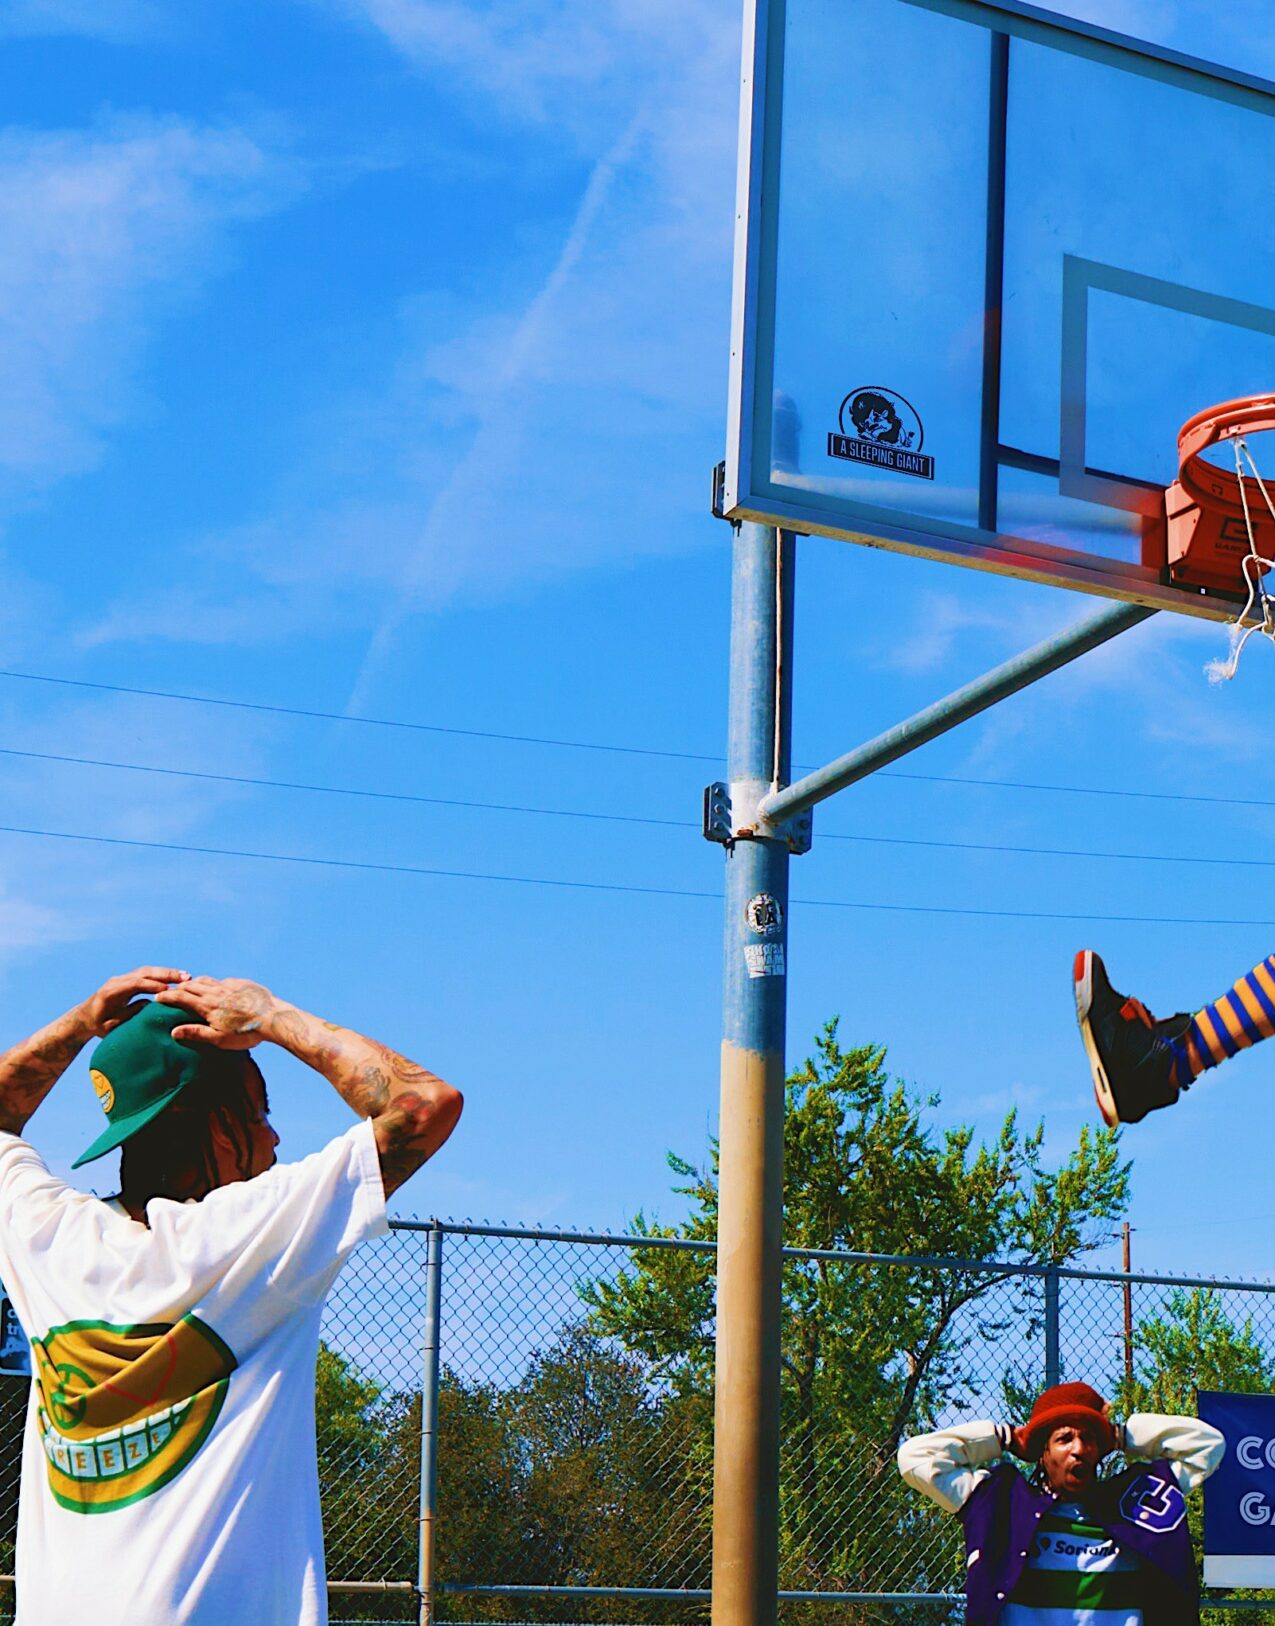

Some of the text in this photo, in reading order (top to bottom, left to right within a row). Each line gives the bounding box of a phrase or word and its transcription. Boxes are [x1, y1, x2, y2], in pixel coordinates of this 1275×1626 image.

[840, 440, 925, 473] A SLEEPING GIANT
[54, 1432, 160, 1470] REEZE
